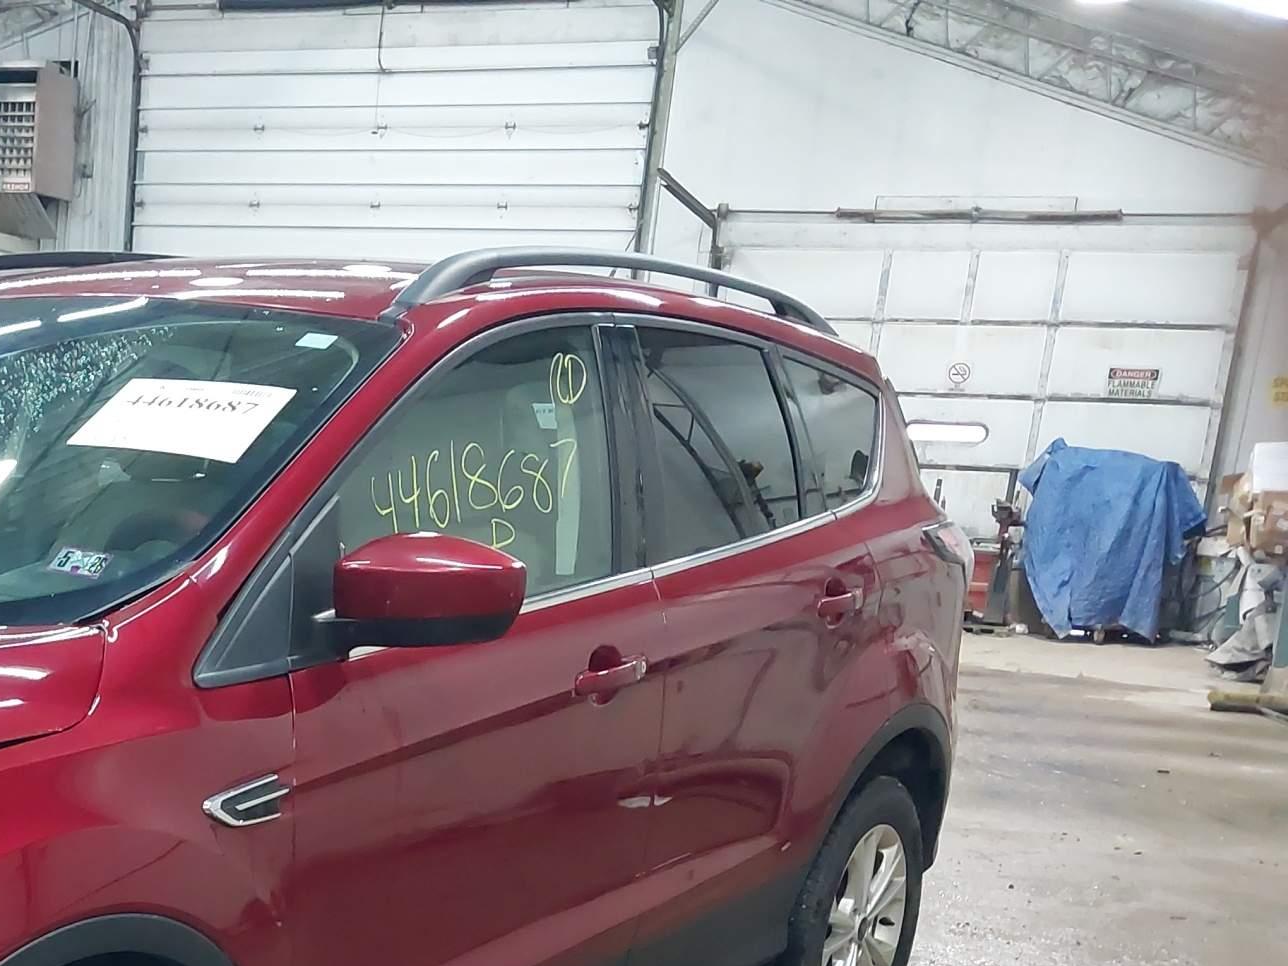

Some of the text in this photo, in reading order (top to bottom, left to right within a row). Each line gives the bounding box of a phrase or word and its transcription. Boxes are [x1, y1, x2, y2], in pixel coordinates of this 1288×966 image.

[1115, 370, 1152, 379] DANGER
[1108, 379, 1155, 390] FLAMMABLE
[1108, 388, 1153, 398] MATERIALS
[127, 394, 260, 415] 44618687
[371, 437, 578, 534] 44618687
[57, 550, 75, 568] 5
